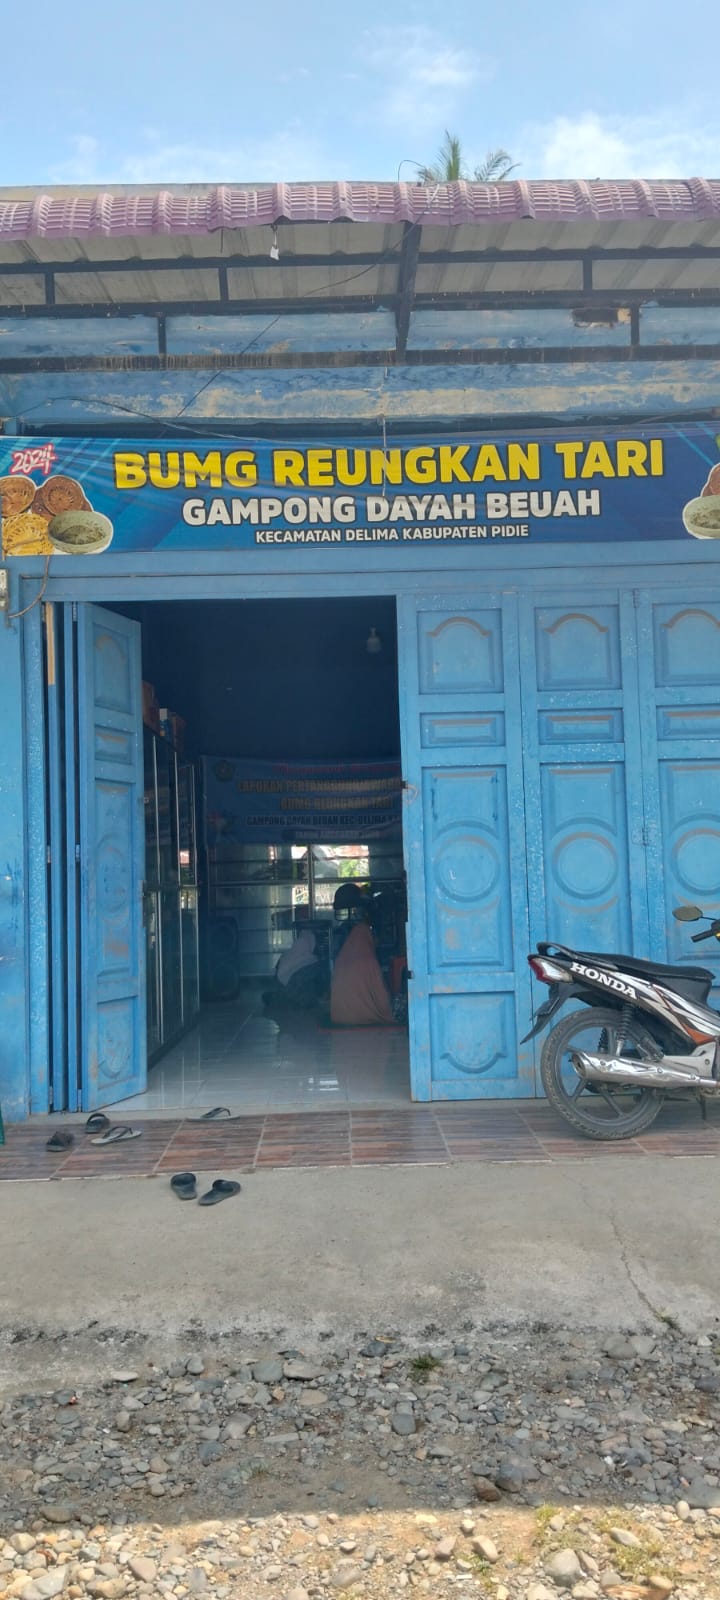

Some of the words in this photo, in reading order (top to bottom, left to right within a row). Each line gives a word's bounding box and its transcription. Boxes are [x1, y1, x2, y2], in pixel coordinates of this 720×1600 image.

[11, 443, 57, 475] 2024
[114, 448, 257, 489] BUMG
[273, 442, 541, 487] REUNGKAN
[555, 439, 664, 479] TARI
[182, 496, 355, 526] GAMPONG
[366, 493, 476, 523] DAYAH
[486, 489, 601, 519] BEUAH
[255, 529, 341, 544] KECAMATAN
[345, 527, 398, 542] DELIMA
[402, 525, 487, 540] KABUPATEN
[491, 524, 529, 537] PIDIE
[569, 961, 637, 1000] HONDA
